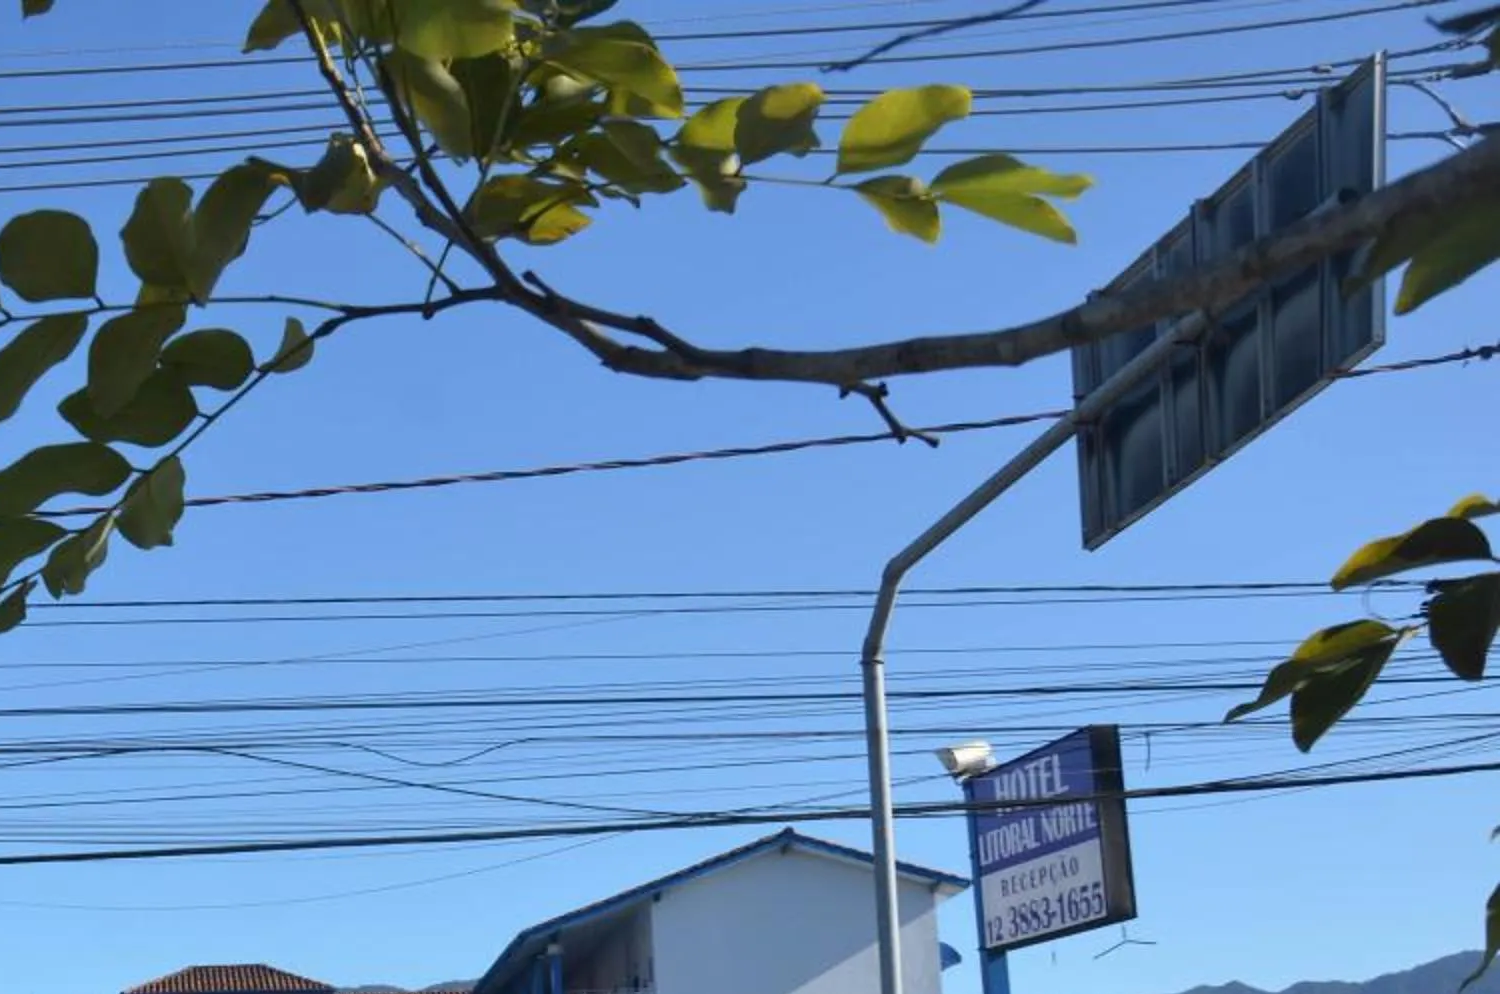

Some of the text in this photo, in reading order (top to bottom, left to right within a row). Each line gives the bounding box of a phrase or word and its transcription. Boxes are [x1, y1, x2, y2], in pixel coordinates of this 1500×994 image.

[994, 753, 1070, 815] HOTEL
[978, 802, 1098, 866] LITORAL NORTE
[1000, 854, 1080, 897] RECEPÇÃO
[986, 881, 1103, 945] 12 3883-1655
